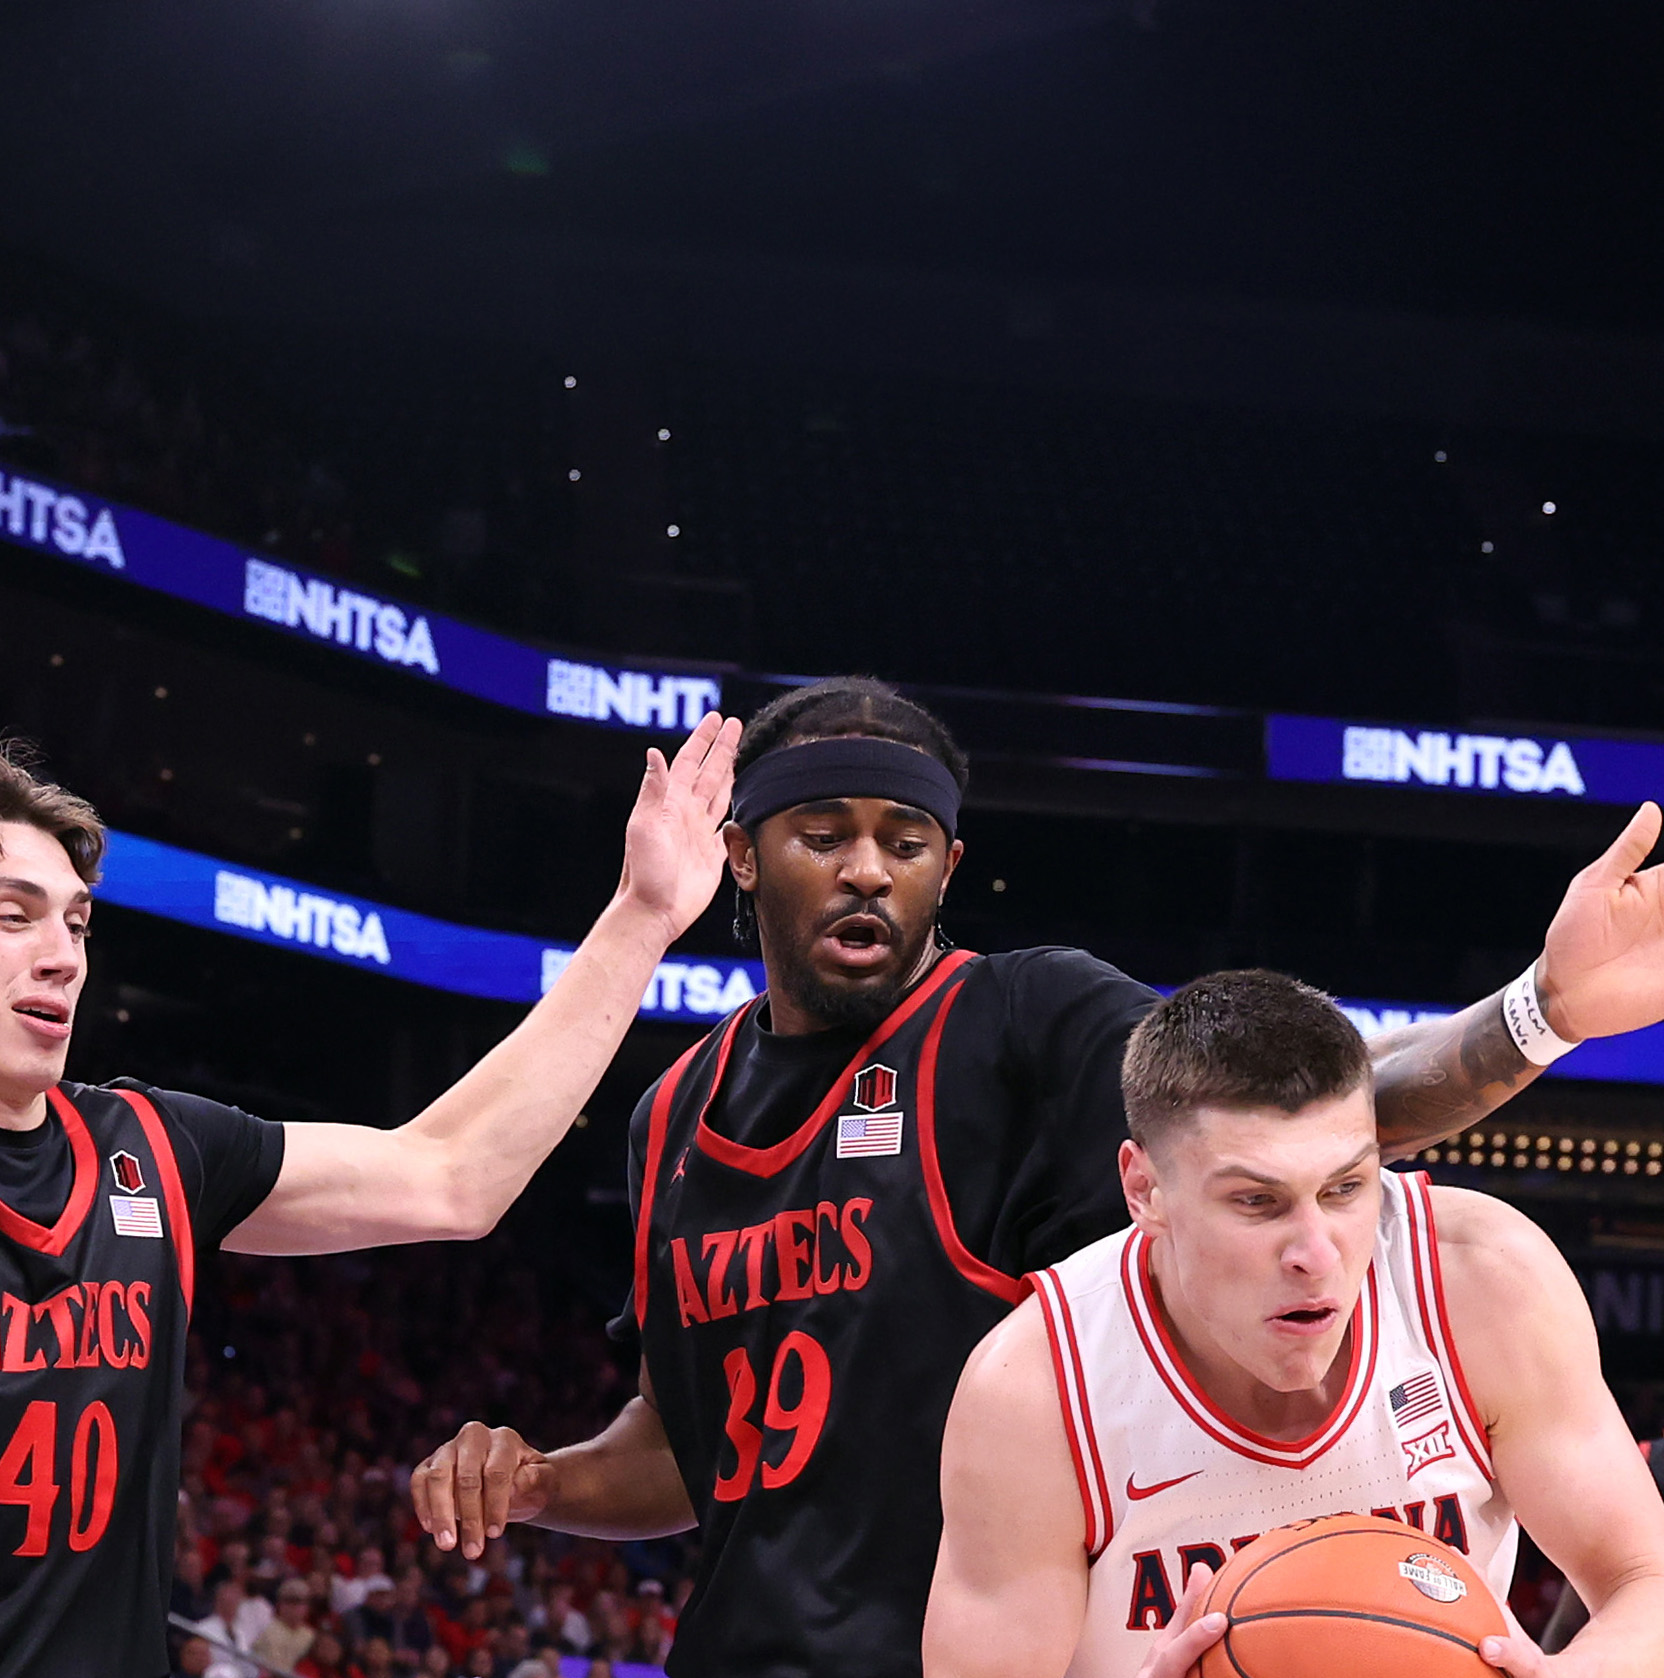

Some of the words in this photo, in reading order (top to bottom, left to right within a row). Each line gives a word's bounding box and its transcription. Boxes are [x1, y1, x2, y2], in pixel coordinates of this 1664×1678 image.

[287, 573, 439, 675] NHTSA
[599, 670, 720, 731] NHT
[1396, 731, 1585, 796] NHTSA
[248, 879, 390, 965] NHTSA
[641, 962, 757, 1014] TSA
[670, 1197, 875, 1328] AZTECS
[714, 1331, 832, 1502] 39
